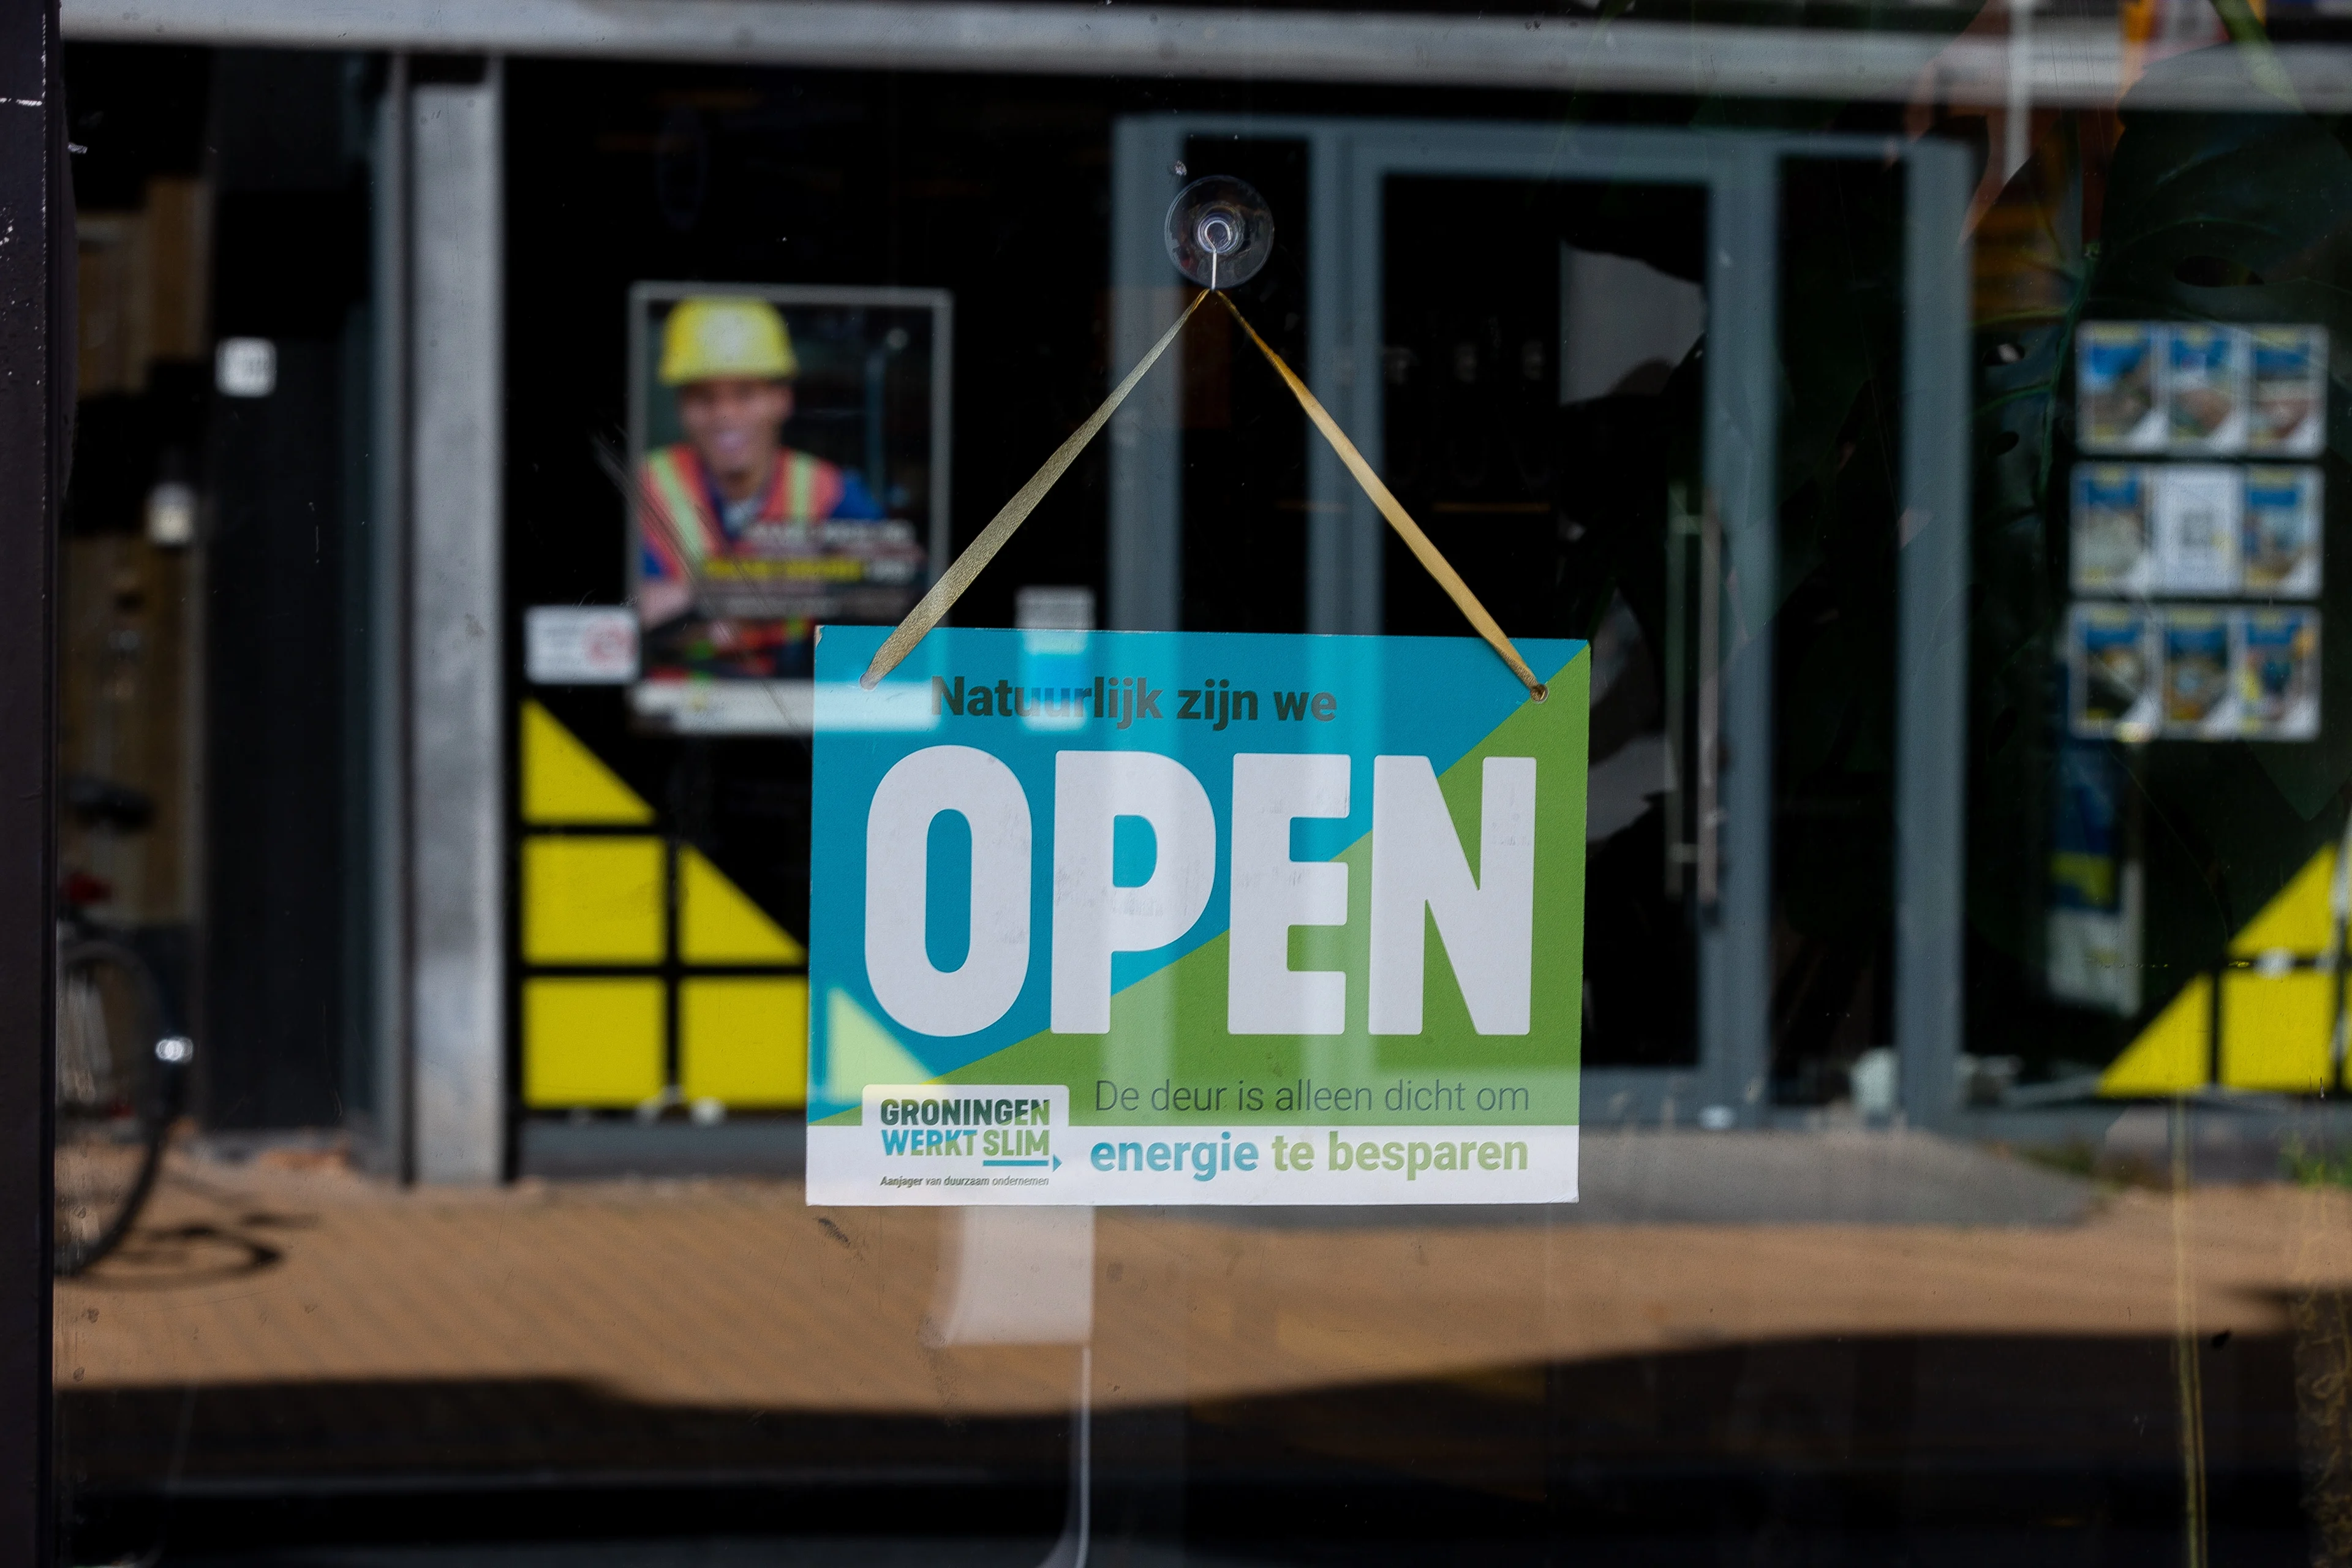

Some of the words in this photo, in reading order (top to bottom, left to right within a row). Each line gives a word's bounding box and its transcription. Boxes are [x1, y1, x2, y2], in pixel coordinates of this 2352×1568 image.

[931, 676, 1164, 729] Natuurlijk
[1177, 679, 1258, 731] zijn
[1273, 692, 1337, 722] we
[864, 744, 1536, 1036] OPEN
[1096, 1080, 1139, 1110] De
[1152, 1079, 1227, 1111] deur
[1238, 1080, 1264, 1111] is
[1276, 1079, 1372, 1111] alleen
[1385, 1079, 1466, 1111] dicht
[1477, 1087, 1529, 1111] om
[880, 1098, 1050, 1126] GRONINGEN
[881, 1129, 978, 1156] WERKT
[982, 1129, 1050, 1156] SLIM
[1090, 1131, 1259, 1182] energie
[1272, 1136, 1314, 1171] te
[1328, 1131, 1528, 1181] besparen
[880, 1175, 923, 1188] Aanjager
[925, 1177, 942, 1186] van
[944, 1175, 990, 1186] duurzaam
[992, 1176, 1050, 1186] ondernemen
